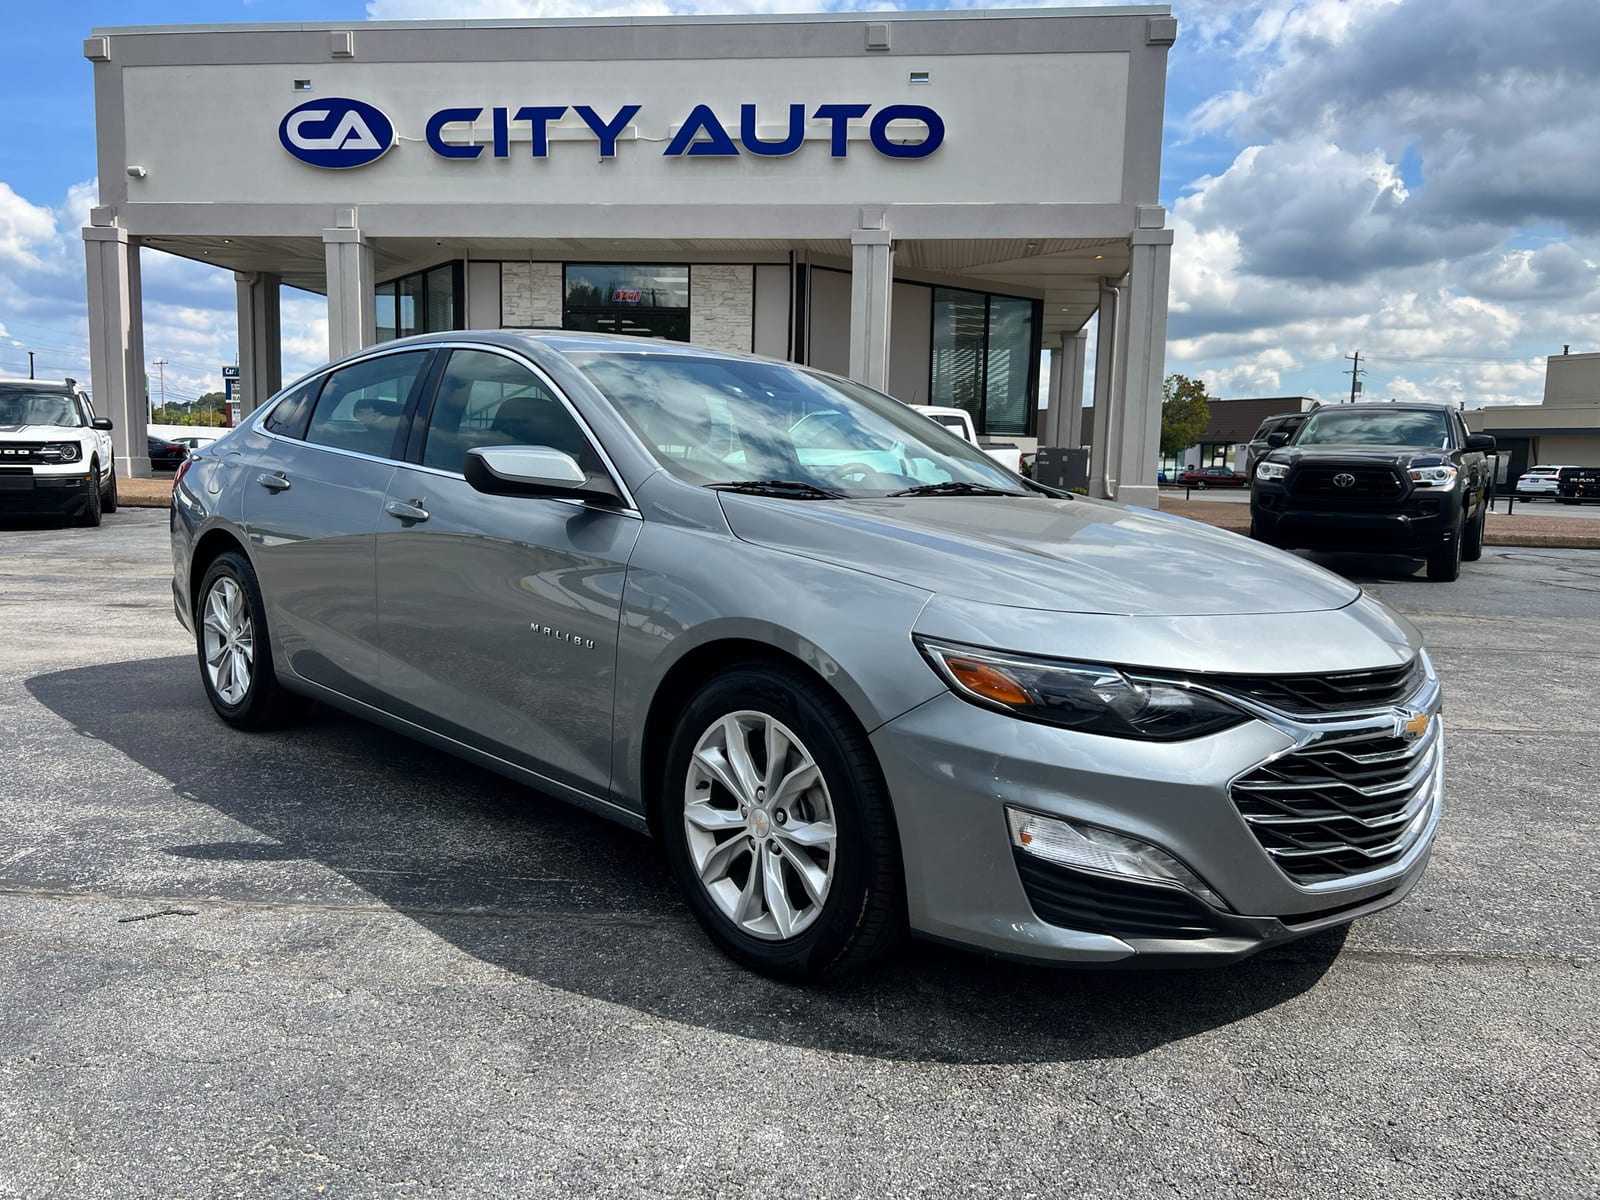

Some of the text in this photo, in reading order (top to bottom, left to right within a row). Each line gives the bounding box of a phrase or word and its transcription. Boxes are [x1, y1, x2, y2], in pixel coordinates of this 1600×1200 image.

[286, 110, 383, 150] CA
[425, 104, 945, 159] CITY AUTO
[613, 289, 641, 302] OPEN
[530, 622, 595, 649] MALIBU
